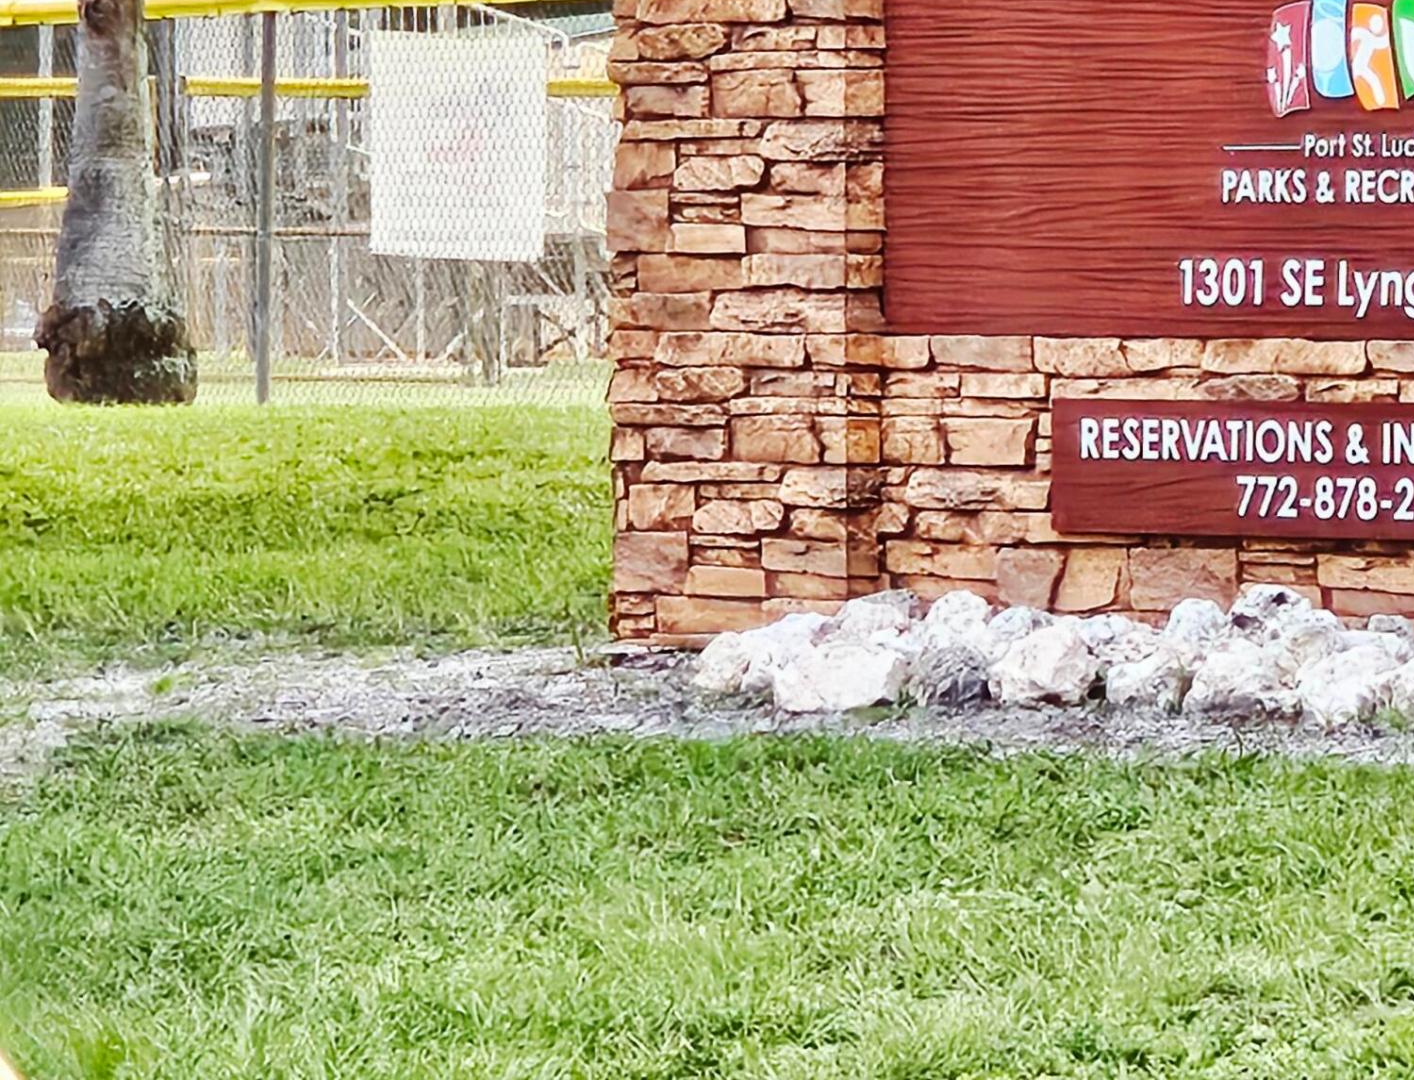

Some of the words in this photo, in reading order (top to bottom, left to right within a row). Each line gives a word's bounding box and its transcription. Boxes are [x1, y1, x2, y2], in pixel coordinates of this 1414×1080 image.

[1303, 132, 1348, 159] Port
[1351, 132, 1376, 159] St.
[1221, 168, 1308, 204] PARKS
[1314, 170, 1336, 205] &
[1178, 258, 1264, 307] 1301
[1279, 258, 1326, 307] SE
[1079, 416, 1334, 465] RESERVATIONS
[1344, 422, 1371, 466] &
